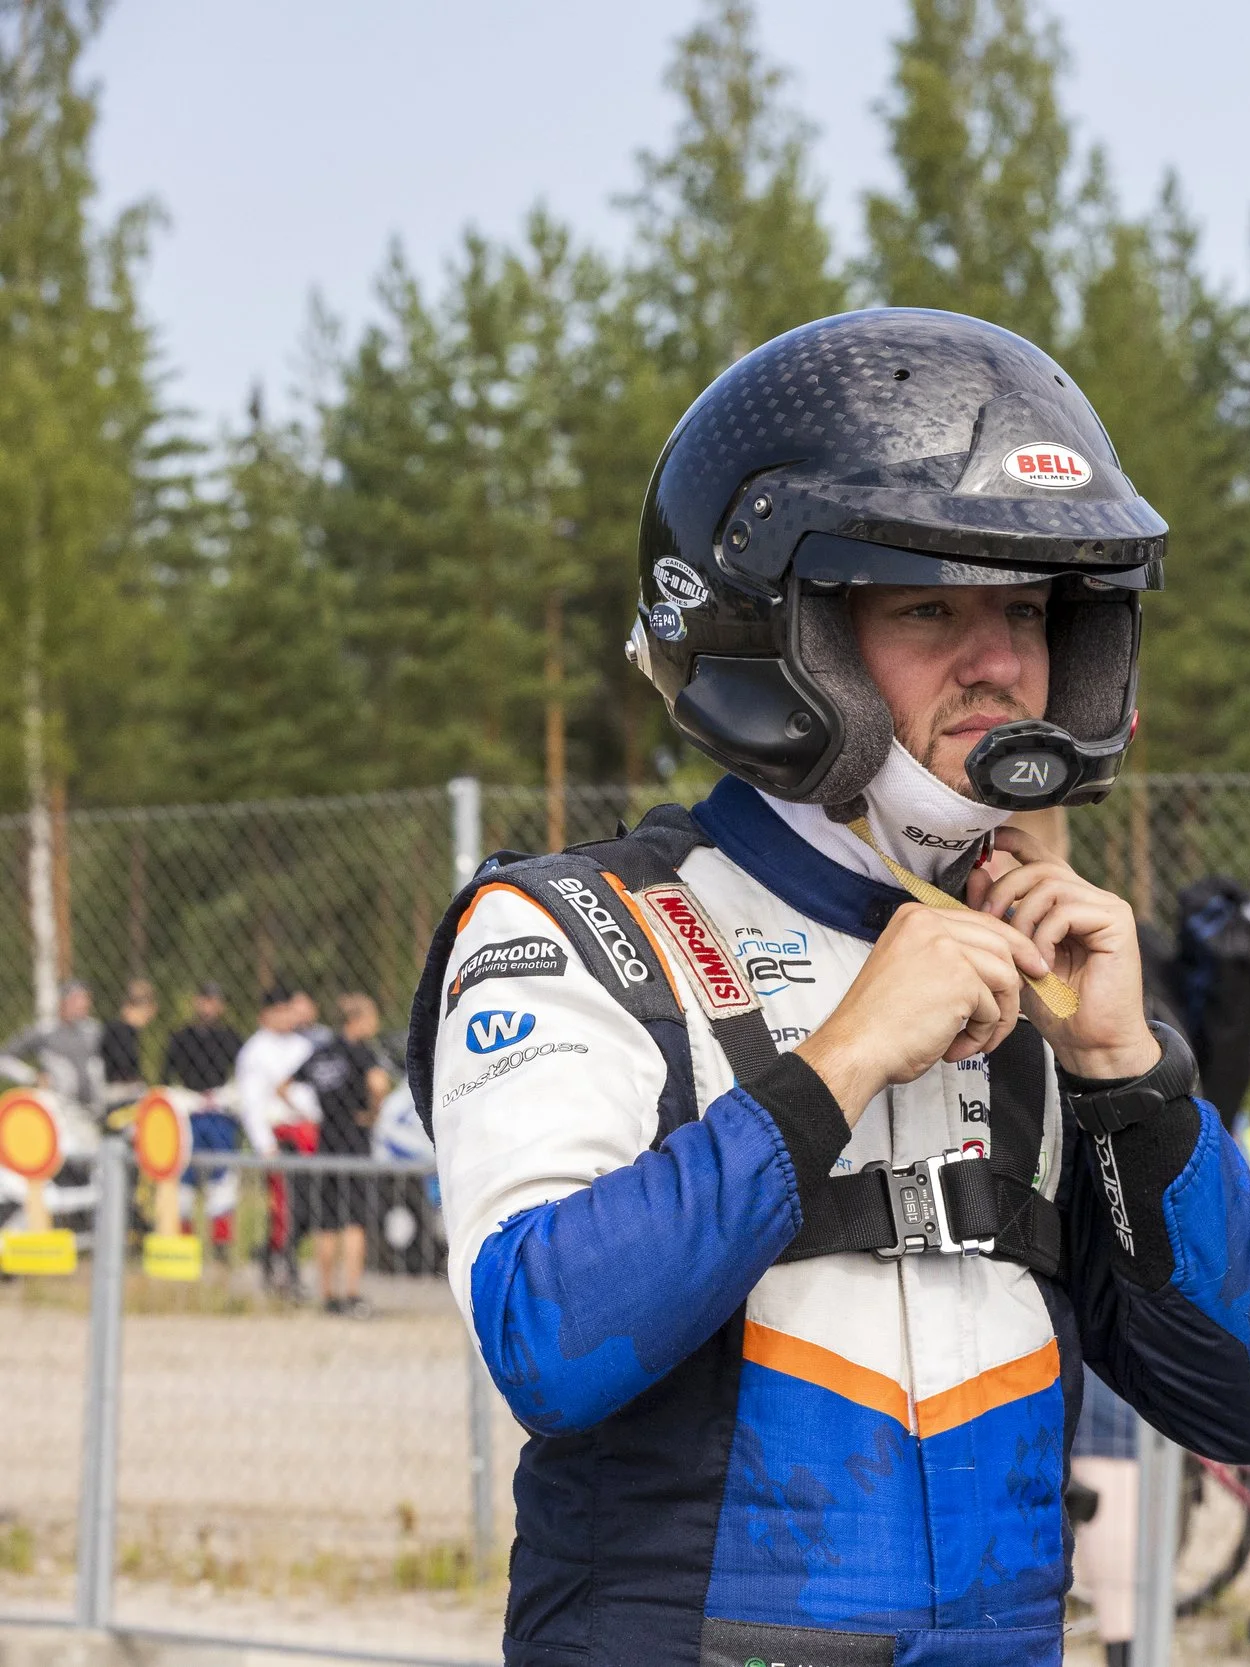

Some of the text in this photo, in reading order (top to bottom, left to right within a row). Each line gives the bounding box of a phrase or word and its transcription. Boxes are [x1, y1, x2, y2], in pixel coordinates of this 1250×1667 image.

[1016, 454, 1083, 476] BELL
[1029, 474, 1077, 482] HELMETS
[665, 559, 695, 578] CARBON
[679, 578, 710, 603] RALLY
[1009, 761, 1049, 788] ZN
[902, 826, 974, 851] spar
[548, 878, 649, 988] sparco
[735, 928, 763, 938] FIA
[656, 897, 741, 1000] SIMPSON
[474, 959, 557, 978] driving emotion
[746, 957, 816, 983] RC
[957, 1060, 984, 1071] LUBRI
[959, 1093, 984, 1123] ha
[836, 1157, 853, 1171] RT
